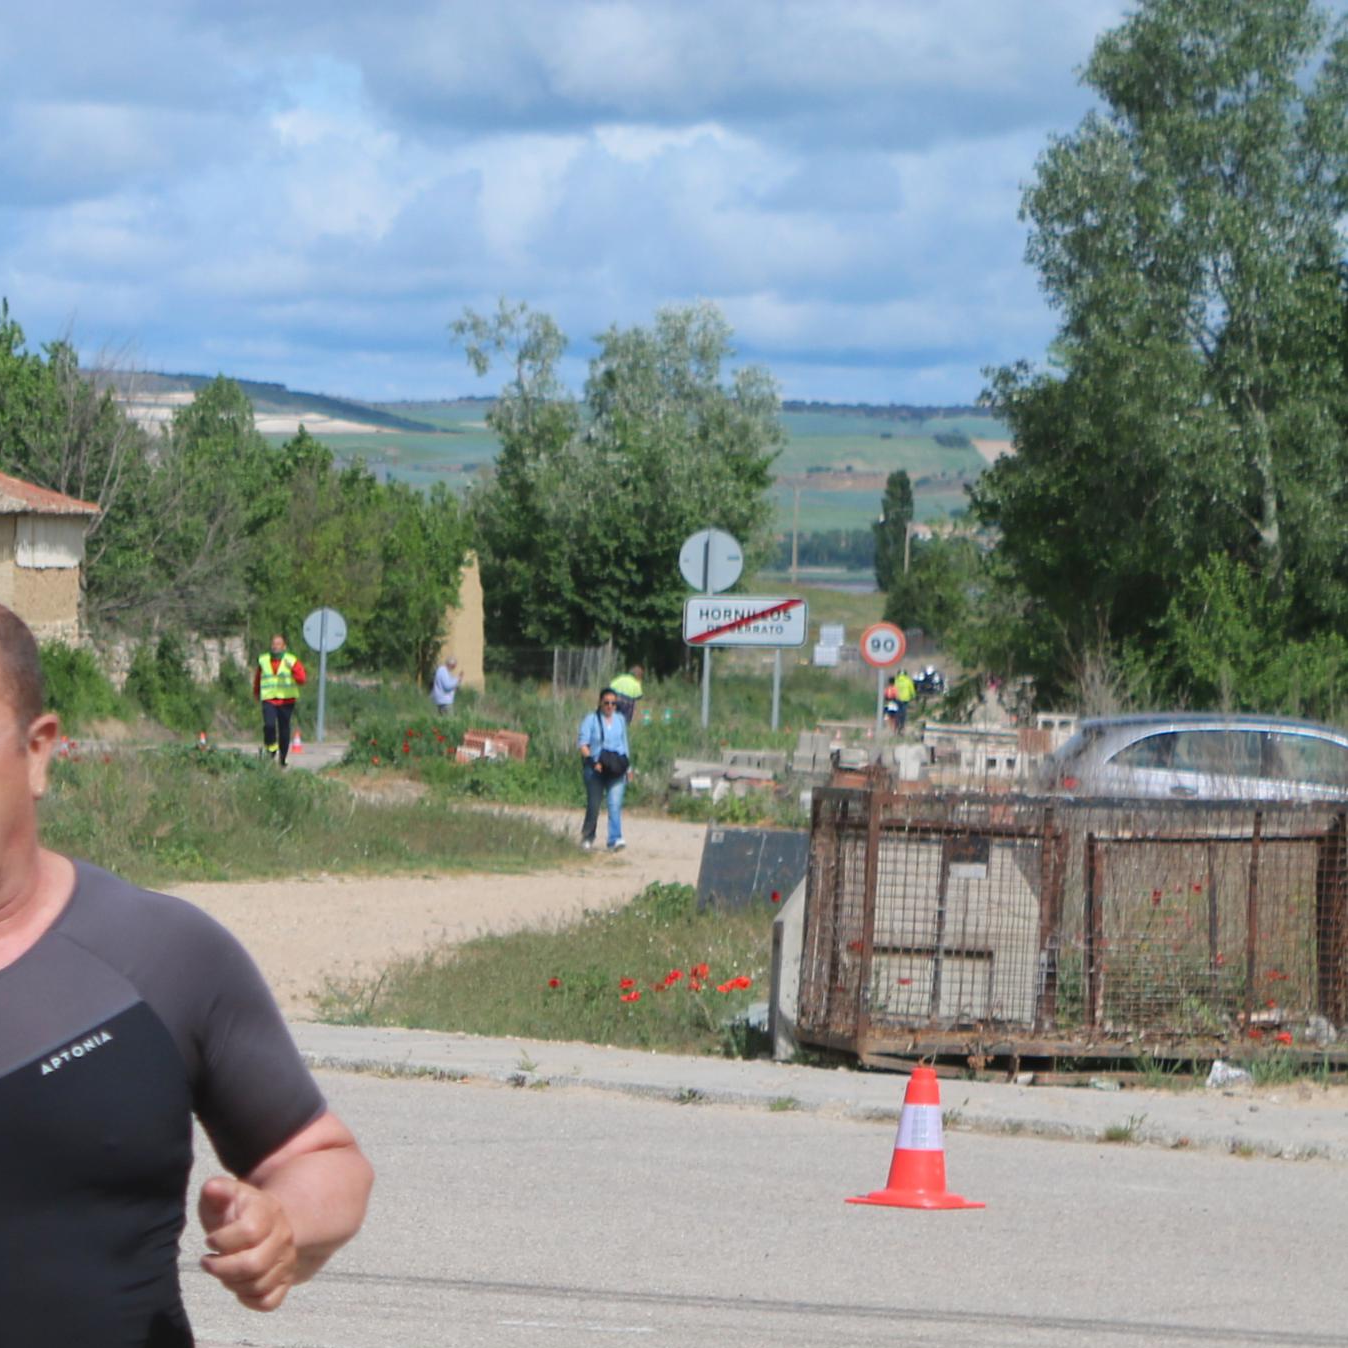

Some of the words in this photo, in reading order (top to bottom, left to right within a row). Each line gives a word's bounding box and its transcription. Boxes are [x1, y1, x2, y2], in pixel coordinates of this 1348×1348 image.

[699, 607, 792, 622] HORNILLOS
[870, 639, 895, 653] 90
[40, 1030, 113, 1076] APTONIA
